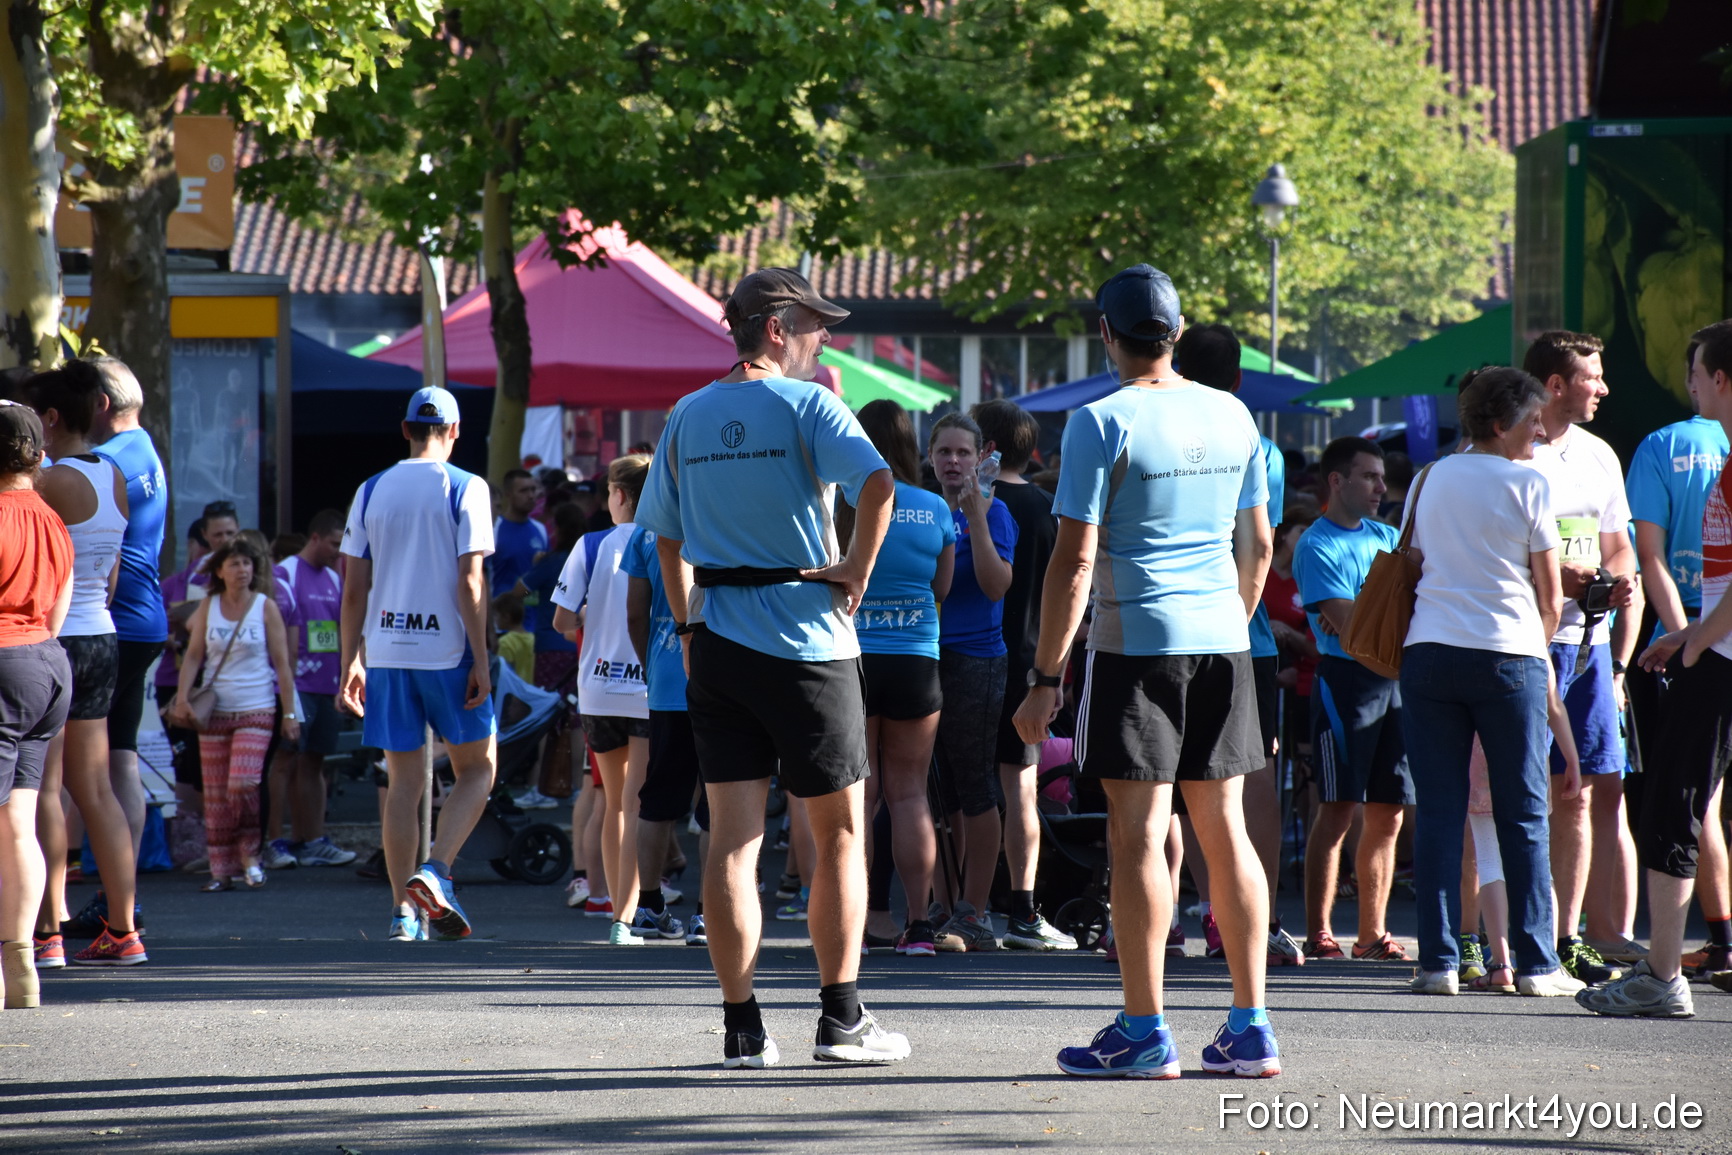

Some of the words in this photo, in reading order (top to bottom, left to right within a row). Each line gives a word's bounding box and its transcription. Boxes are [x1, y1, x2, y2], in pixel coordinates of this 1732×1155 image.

[685, 455, 709, 466] Unsere
[710, 452, 735, 461] Stärke
[737, 451, 750, 459] das
[752, 449, 767, 458] sind
[769, 449, 786, 458] WIR
[1141, 471, 1171, 481] Unsere
[1173, 467, 1197, 477] Stärke
[1199, 466, 1212, 475] das
[1214, 465, 1228, 474] sind
[1229, 465, 1241, 473] WIR
[1561, 537, 1593, 556] 717
[317, 631, 335, 644] 691
